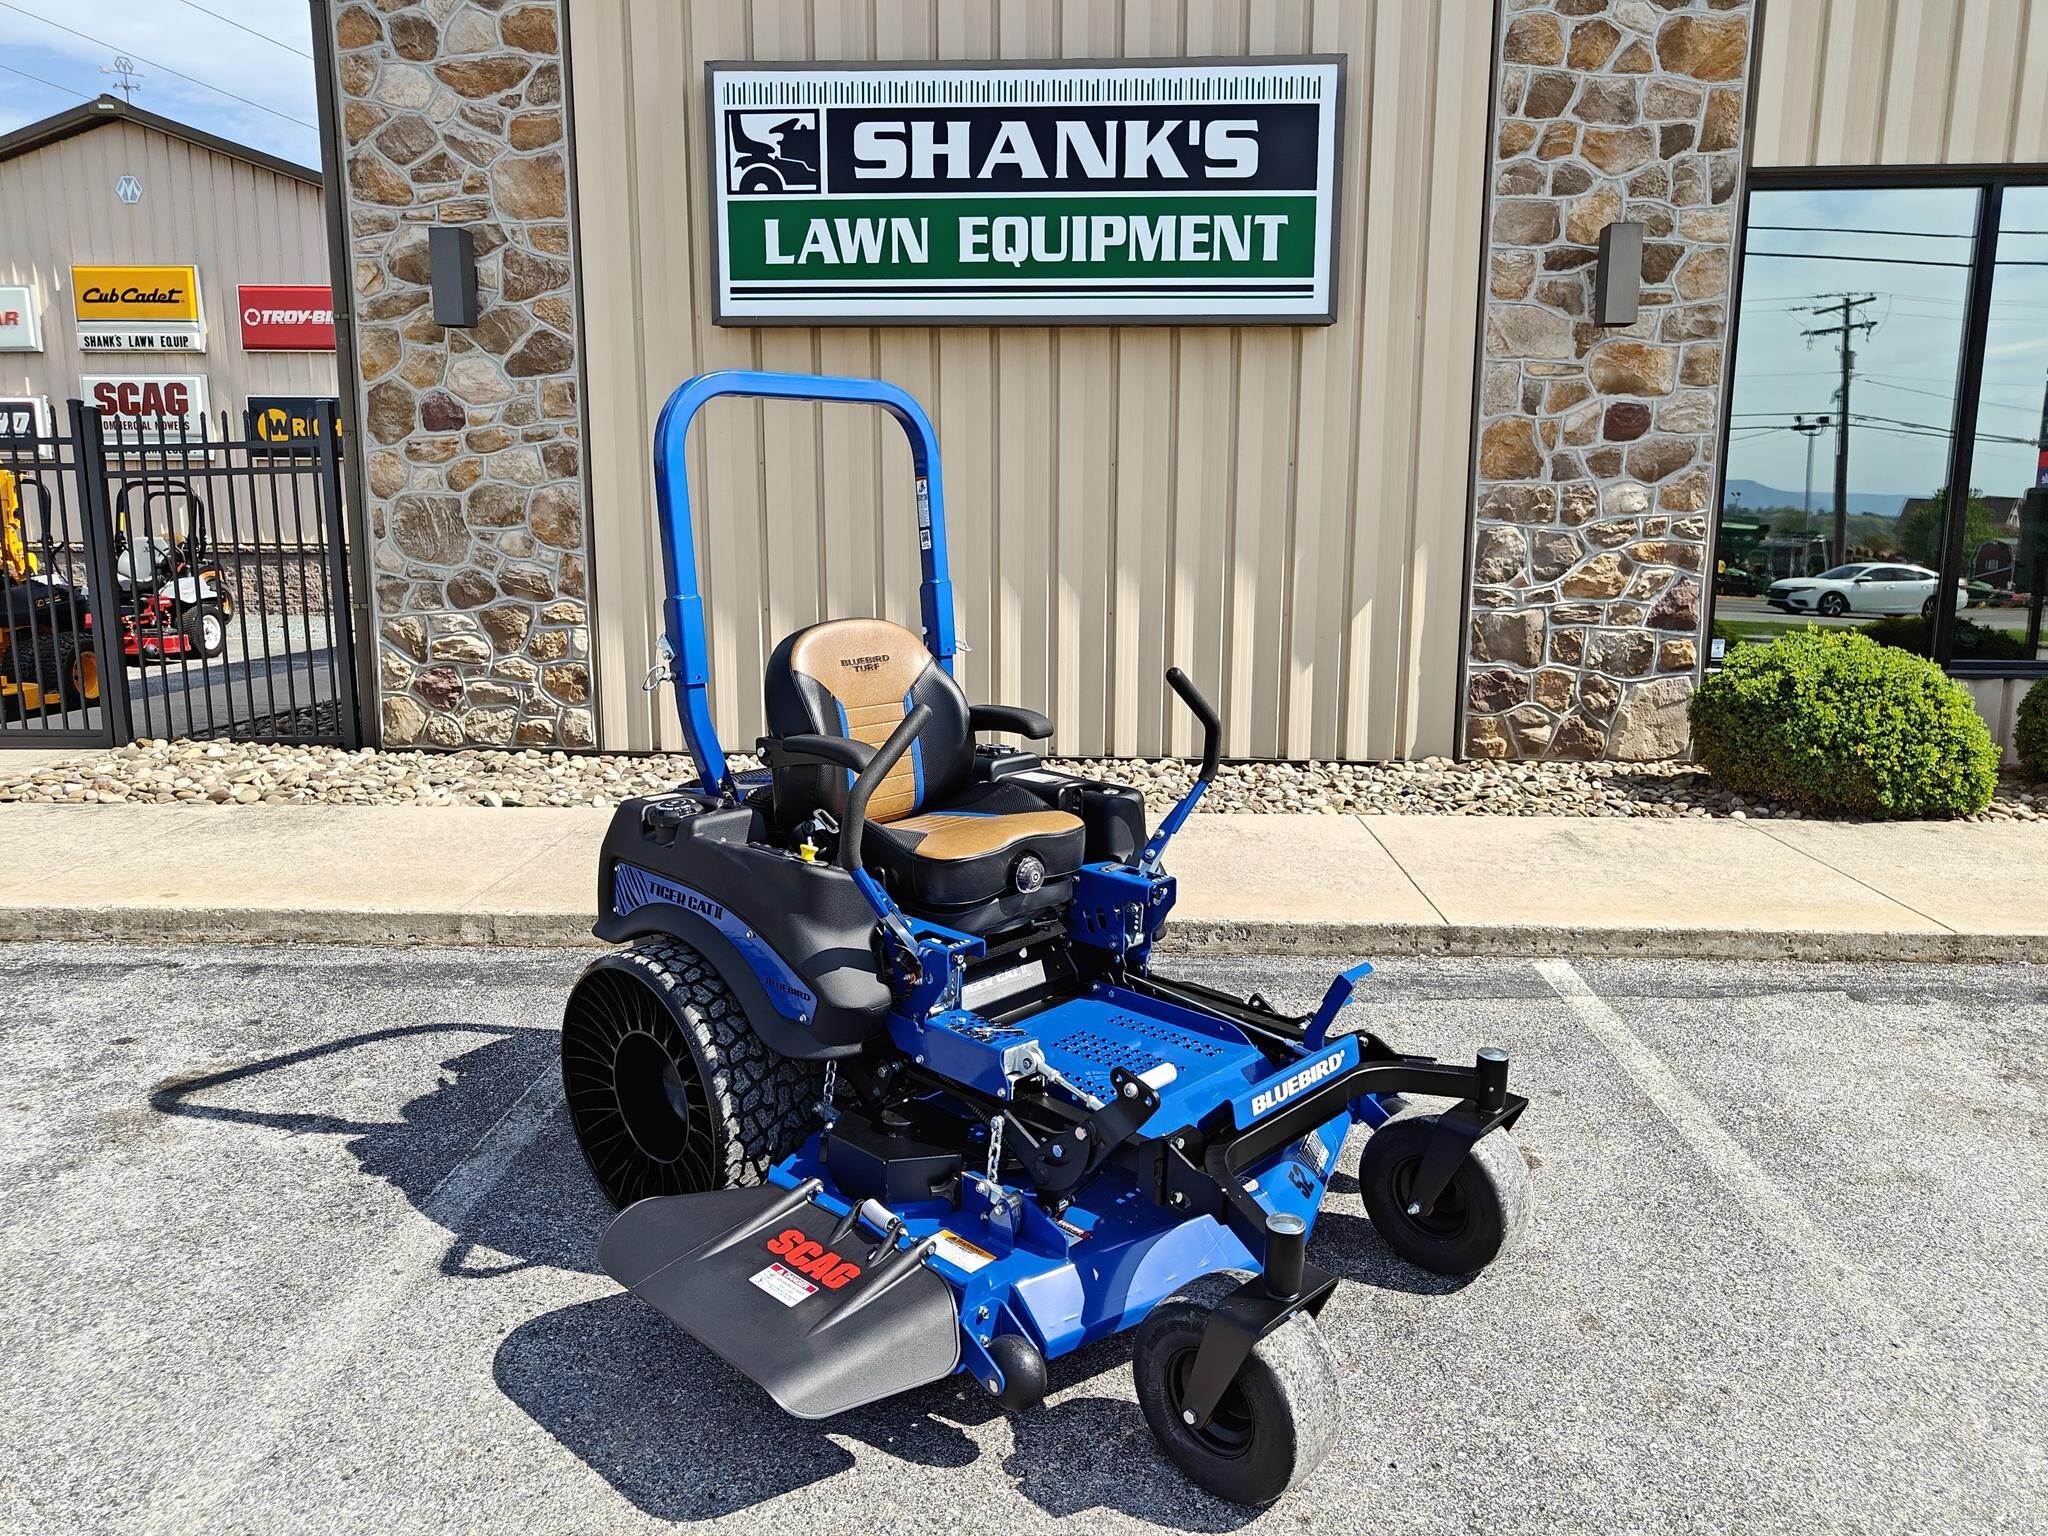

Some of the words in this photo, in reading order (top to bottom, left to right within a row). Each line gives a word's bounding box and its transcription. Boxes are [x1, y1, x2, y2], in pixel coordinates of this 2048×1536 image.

[853, 119, 1260, 179] SHANK'S
[764, 217, 929, 265] LAWN
[958, 214, 1289, 268] EQUIPMENT
[82, 287, 120, 304] Cub
[120, 287, 183, 304] Cadet
[261, 309, 334, 325] TROY-BI
[84, 334, 122, 348] SHANK'S
[128, 335, 154, 348] LAWN
[93, 382, 189, 416] SCAG
[840, 654, 890, 667] BLUEBIRD
[853, 662, 881, 673] TURF
[648, 880, 687, 906] TIGER
[687, 895, 714, 916] CAT
[1251, 1051, 1344, 1117] BLUEBIRD
[766, 1228, 862, 1290] SCAG
